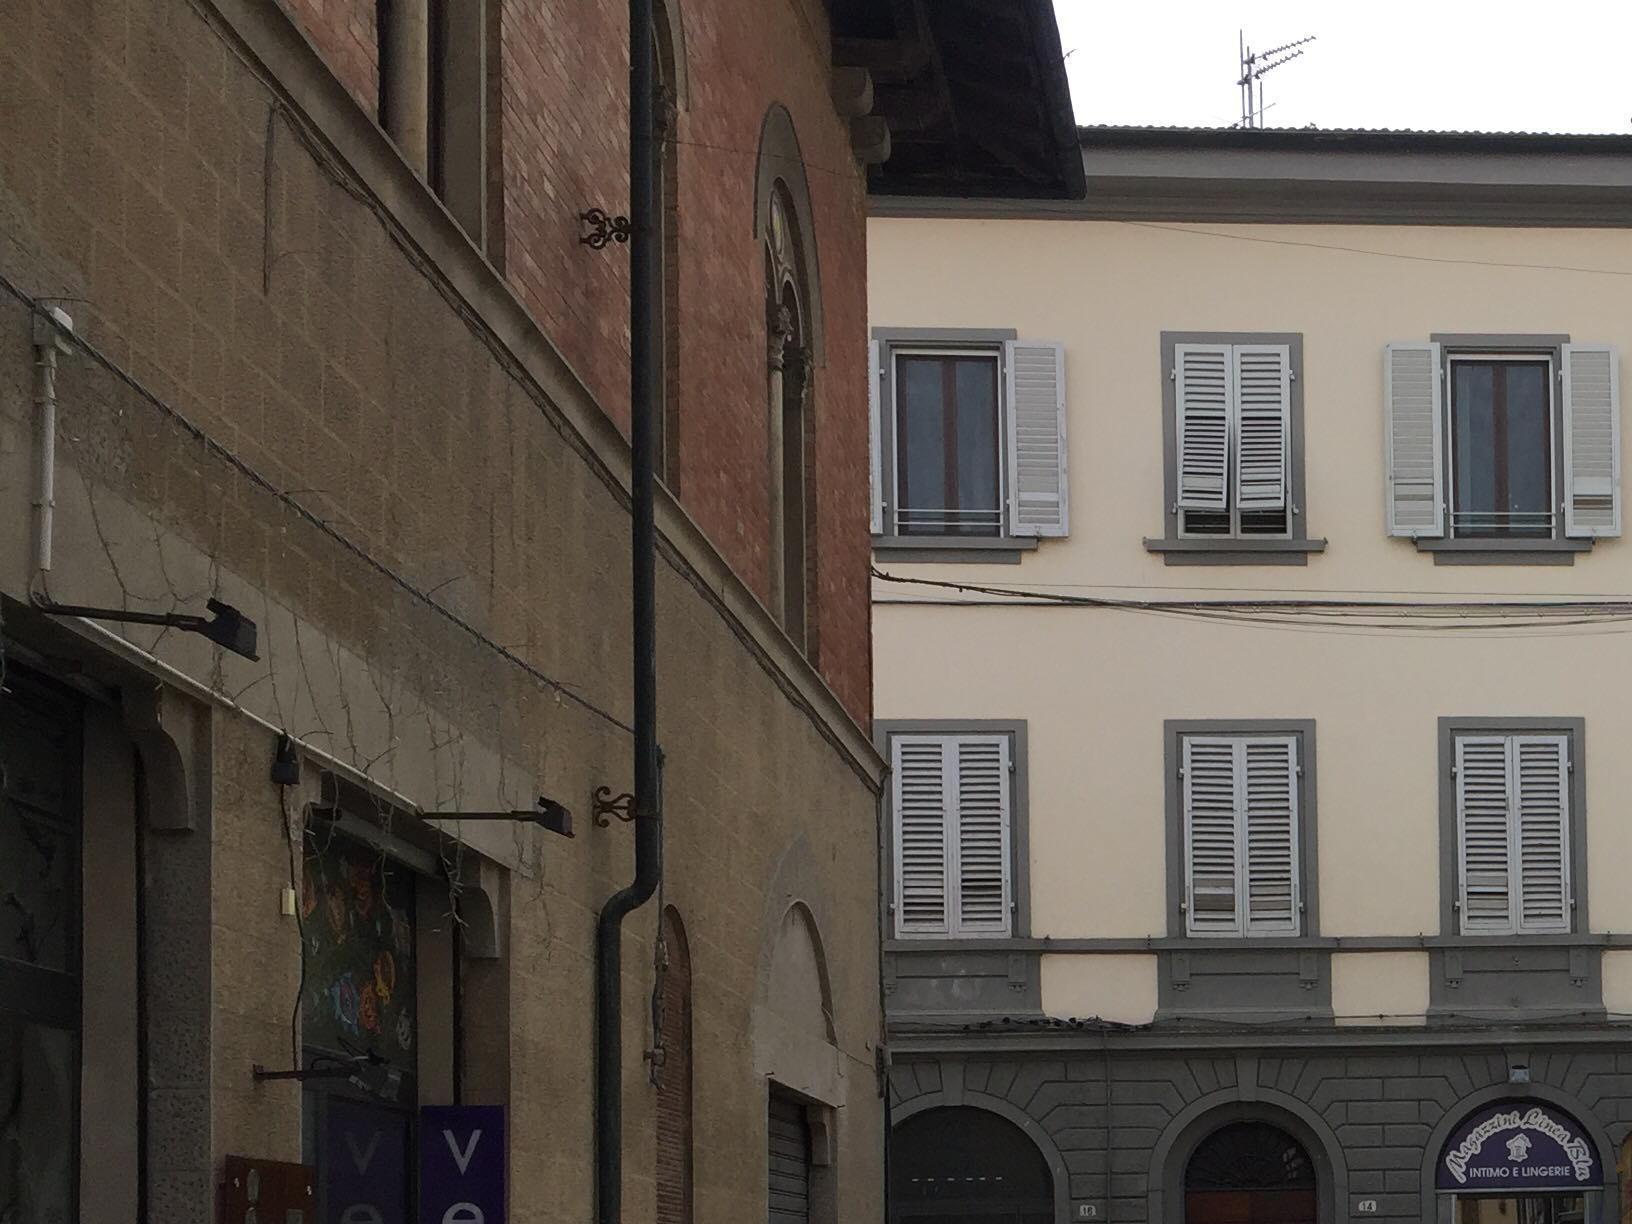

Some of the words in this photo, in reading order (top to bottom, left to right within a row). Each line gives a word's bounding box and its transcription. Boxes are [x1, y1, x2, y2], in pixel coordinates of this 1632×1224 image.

[1446, 1111, 1521, 1183] Magazzini
[1520, 1108, 1571, 1146] Linea
[1469, 1166, 1510, 1178] INTIMO
[1512, 1166, 1519, 1177] E
[1521, 1165, 1571, 1177] LINGERIE
